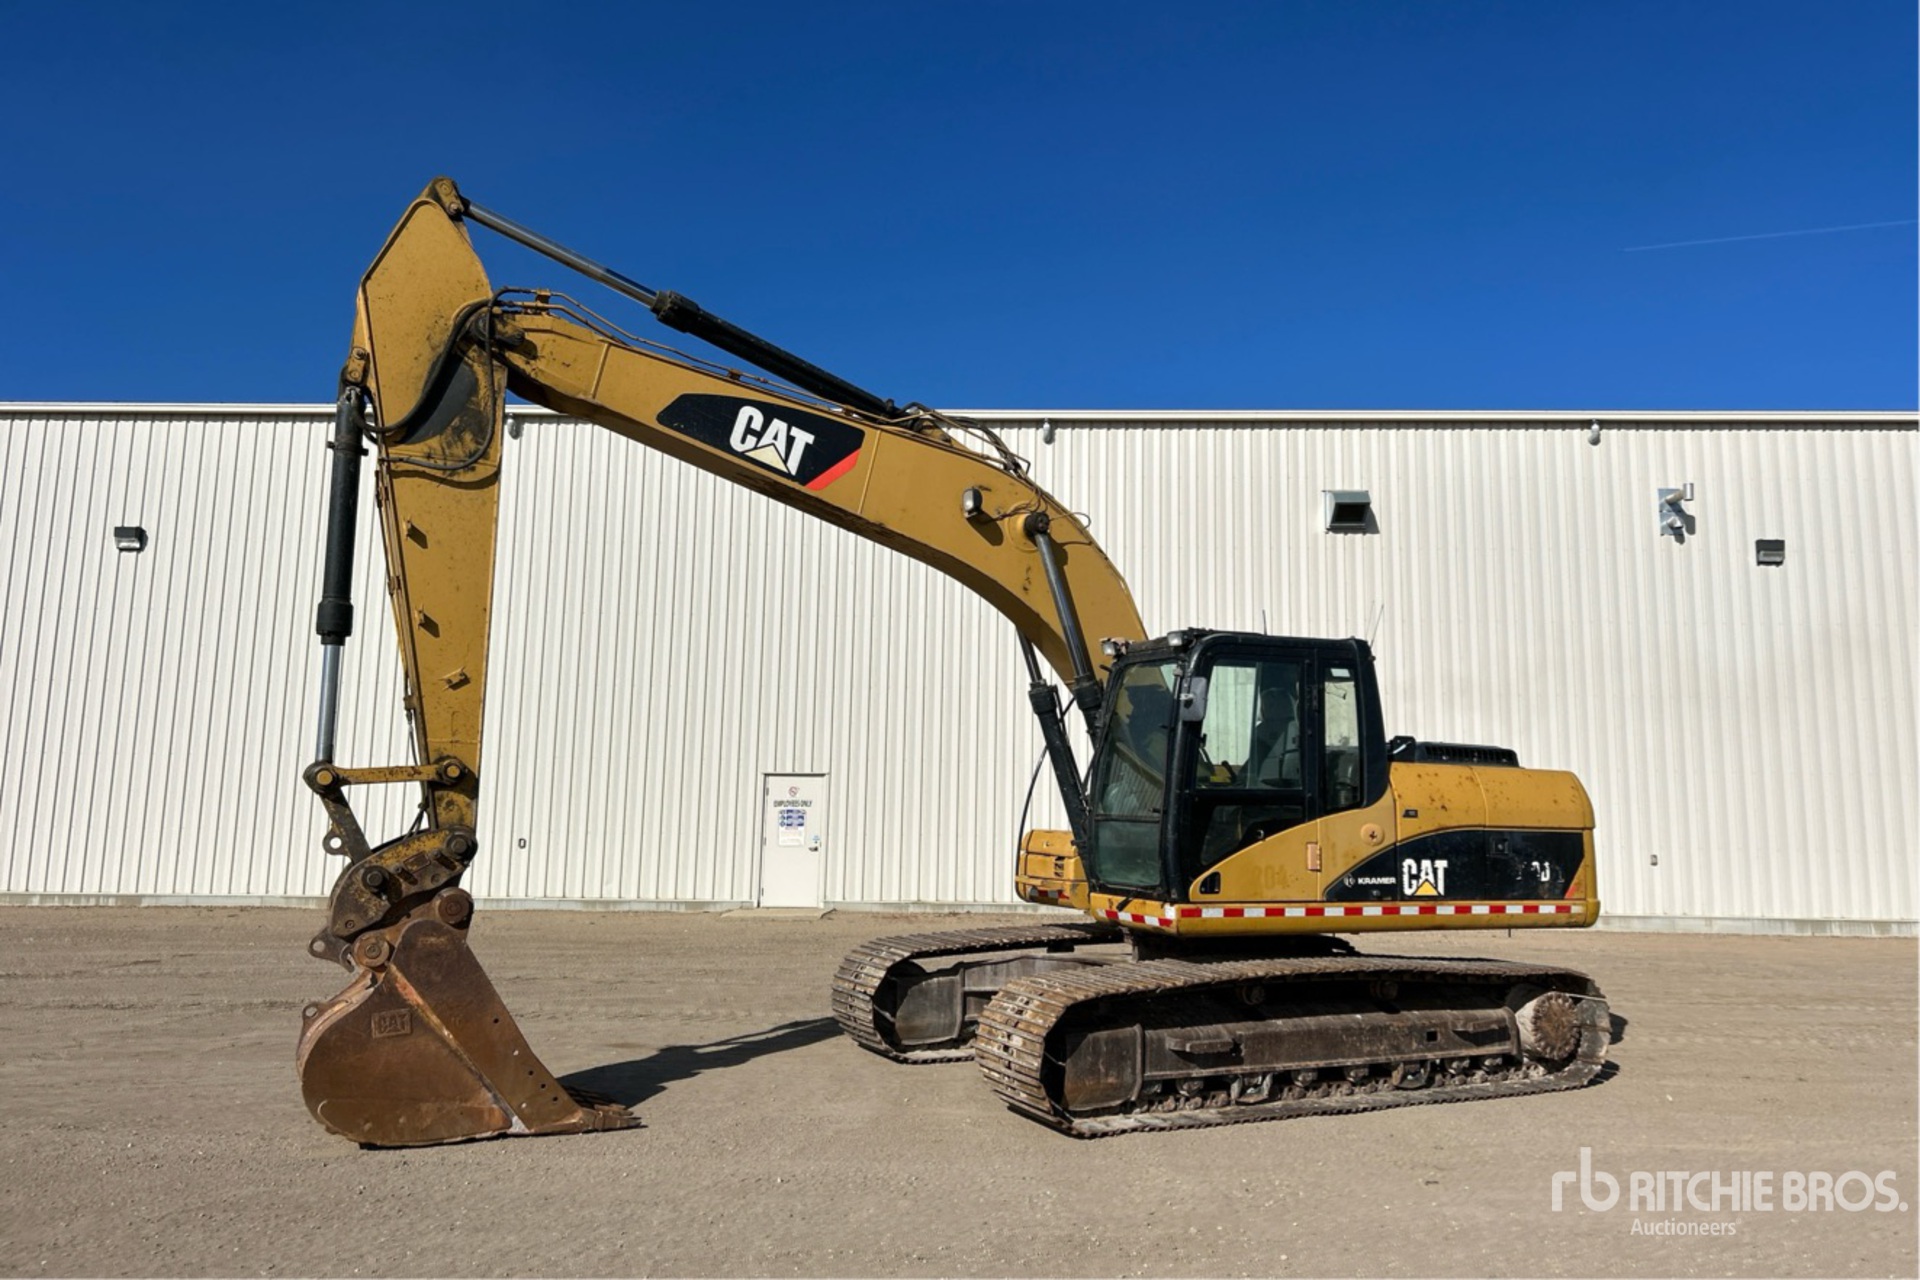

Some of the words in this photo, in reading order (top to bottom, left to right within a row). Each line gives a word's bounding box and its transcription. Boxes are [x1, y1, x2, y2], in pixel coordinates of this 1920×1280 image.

[729, 405, 815, 476] CAT
[1357, 877, 1397, 885] KRAMER
[1402, 858, 1448, 896] CAT
[378, 1013, 407, 1034] CAT
